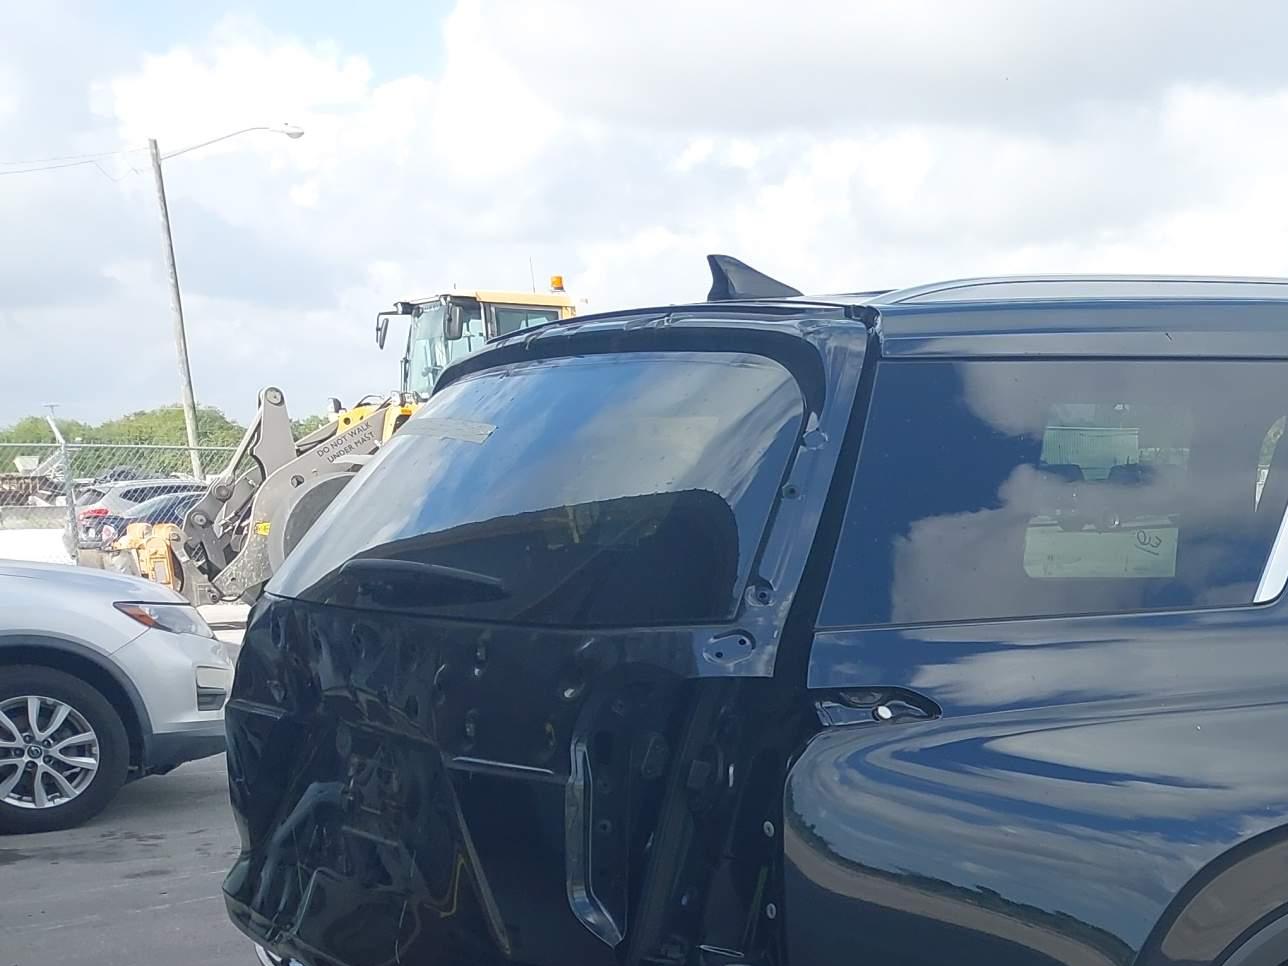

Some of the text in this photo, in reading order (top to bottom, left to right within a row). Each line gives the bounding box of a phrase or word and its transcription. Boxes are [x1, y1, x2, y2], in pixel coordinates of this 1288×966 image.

[316, 421, 372, 457] DO NOT WALK
[327, 431, 375, 463] UNDER MAST
